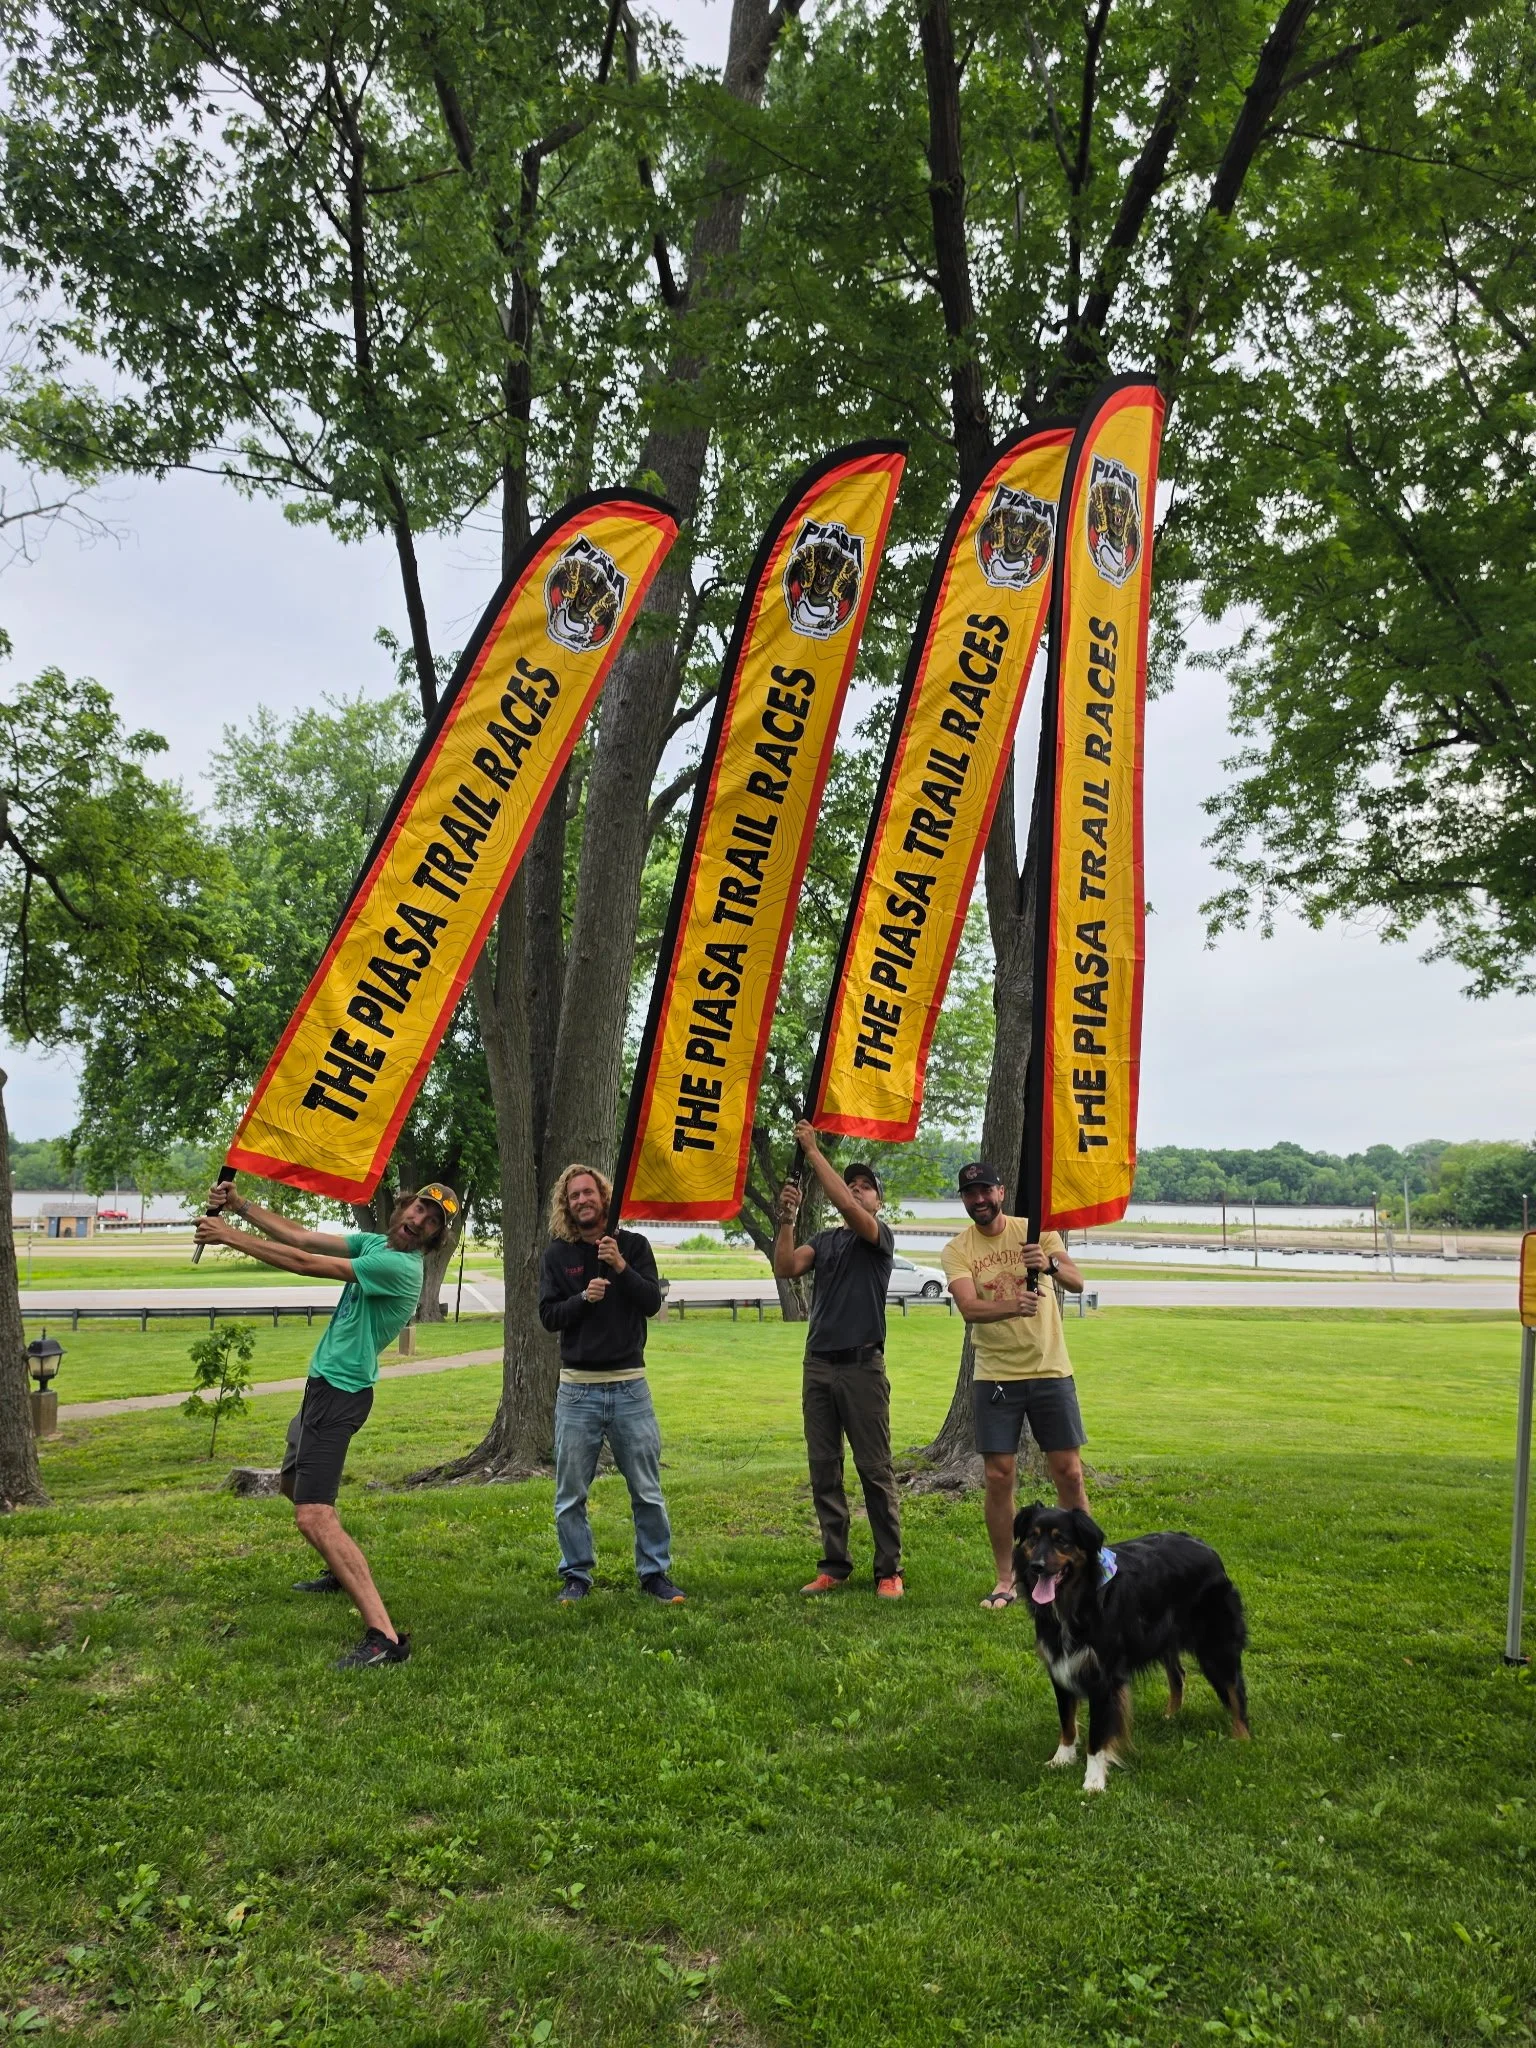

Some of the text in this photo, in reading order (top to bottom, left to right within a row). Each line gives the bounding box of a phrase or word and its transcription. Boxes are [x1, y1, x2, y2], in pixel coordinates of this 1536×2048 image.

[991, 486, 1056, 535] PIASA
[1111, 461, 1123, 470] THE
[563, 537, 627, 606] PIASA
[794, 520, 862, 572] PIASA
[831, 524, 845, 533] THE
[745, 665, 816, 805] RACES
[939, 614, 1010, 745] RACES
[1084, 616, 1118, 766] RACES
[902, 748, 971, 860] TRAIL
[1079, 779, 1110, 902] TRAIL
[301, 656, 560, 1122] THE PIASA TRAIL RACES
[712, 813, 779, 927] TRAIL
[869, 870, 937, 994] PIASA
[1072, 920, 1110, 1055] PIASA
[684, 943, 749, 1068] PIASA
[853, 993, 903, 1073] THE
[672, 1073, 723, 1153] THE
[1072, 1068, 1109, 1153] THE
[972, 1252, 997, 1277] BACK
